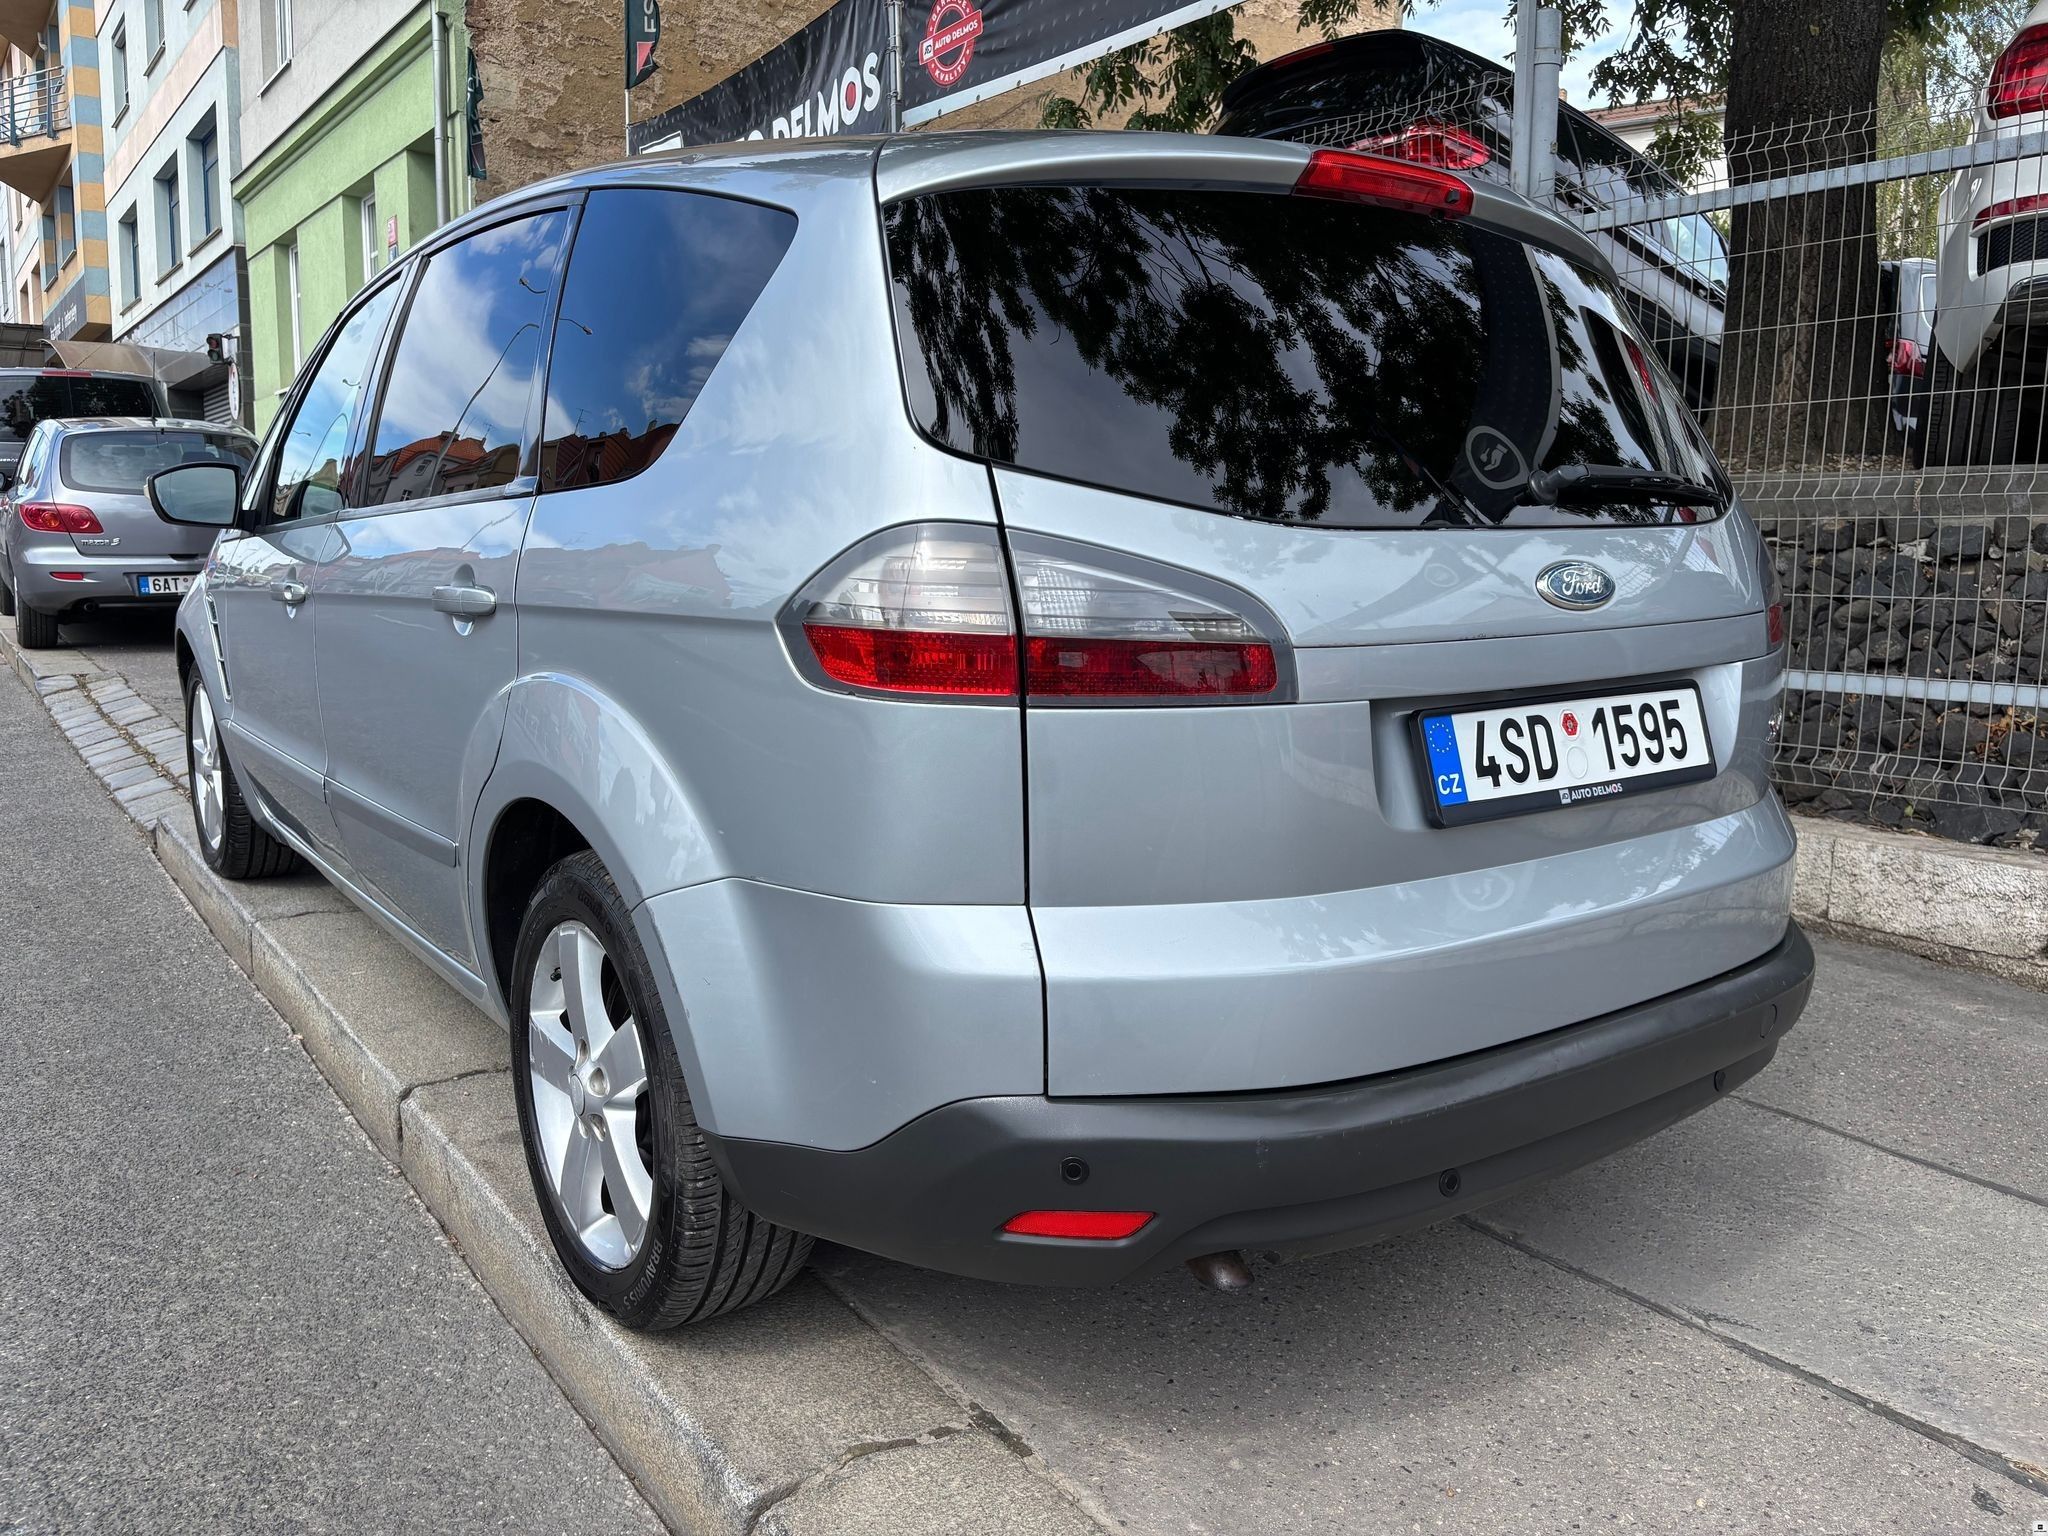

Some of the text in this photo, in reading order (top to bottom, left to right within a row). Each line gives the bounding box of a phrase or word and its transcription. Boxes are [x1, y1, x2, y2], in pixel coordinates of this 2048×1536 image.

[934, 34, 952, 50] AUTO
[952, 19, 978, 41] DELMOS
[935, 57, 966, 81] KVALITY
[152, 577, 180, 592] 6AT
[1562, 569, 1603, 595] Ford
[1438, 699, 1689, 795] CZ 4SD 1595
[1571, 787, 1592, 800] AUTO
[1592, 783, 1623, 796] DELMOS
